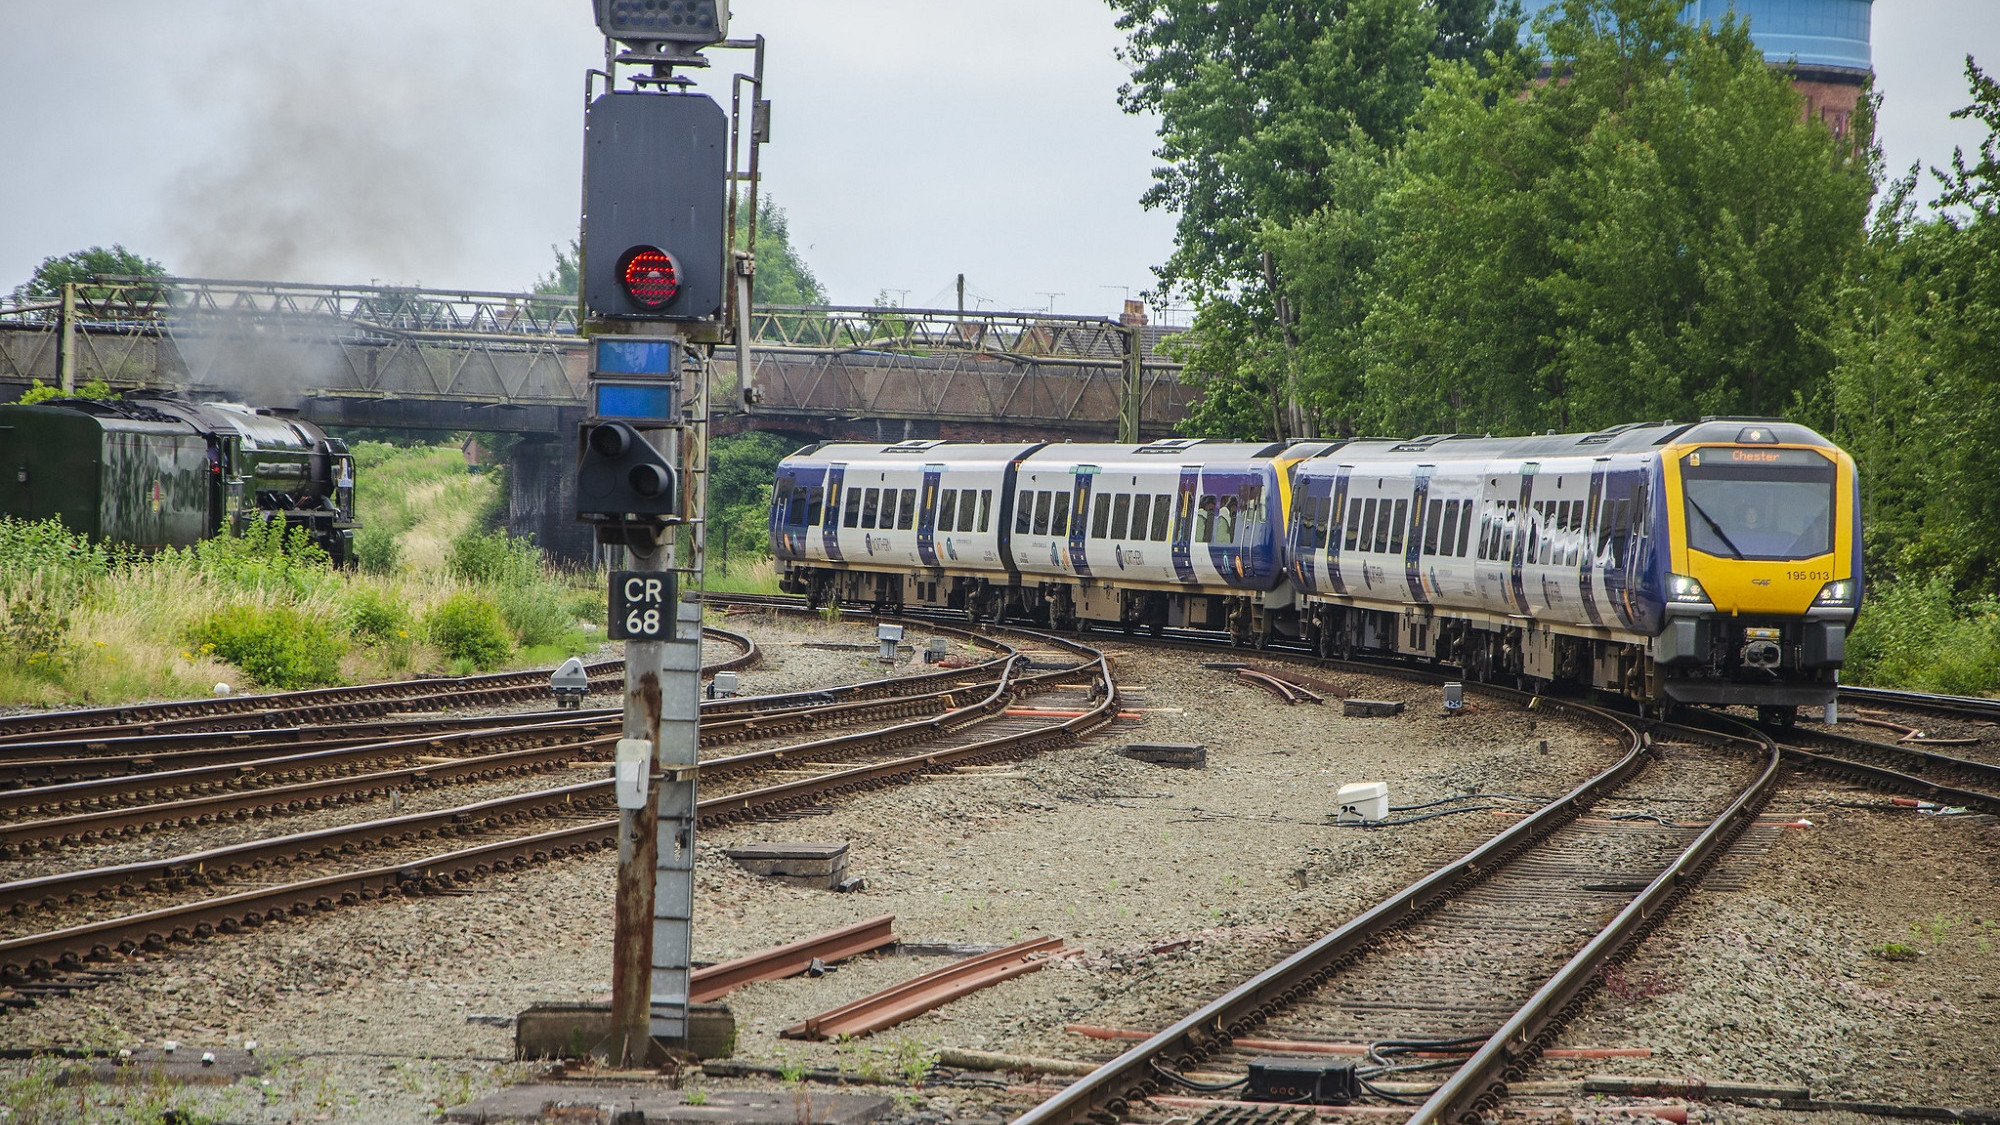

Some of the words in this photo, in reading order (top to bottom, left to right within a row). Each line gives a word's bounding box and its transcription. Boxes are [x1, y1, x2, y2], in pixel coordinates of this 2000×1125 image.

[1732, 450, 1780, 461] Chester
[1787, 571, 1807, 580] 195
[1809, 571, 1830, 580] 013
[624, 577, 662, 602] CR
[626, 609, 660, 634] 68
